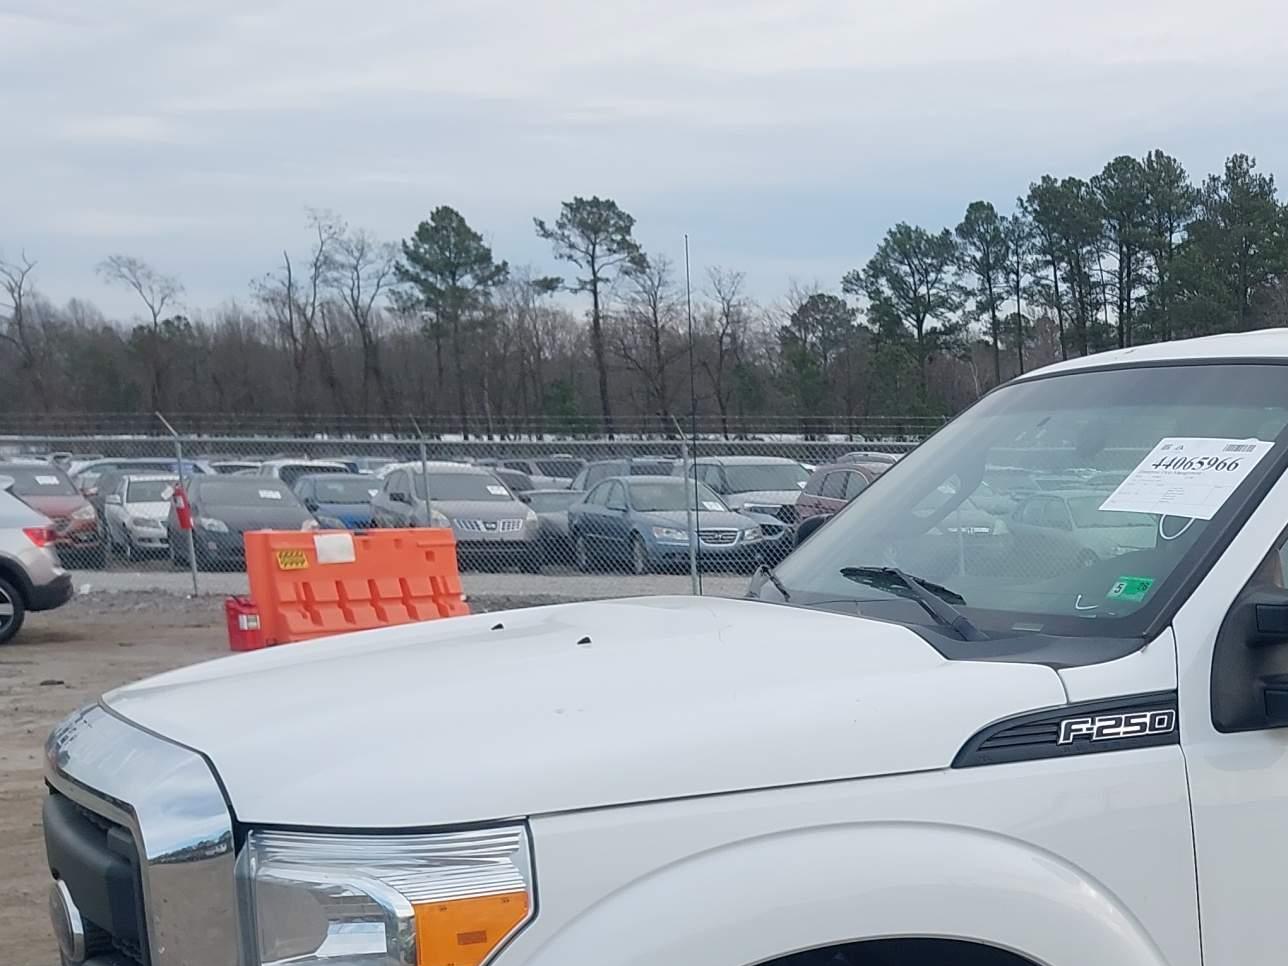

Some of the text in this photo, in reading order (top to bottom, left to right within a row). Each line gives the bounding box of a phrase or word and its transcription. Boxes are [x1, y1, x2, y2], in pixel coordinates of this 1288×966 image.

[1151, 455, 1242, 472] 44065966
[1113, 583, 1125, 594] 5
[1057, 709, 1176, 746] F-250
